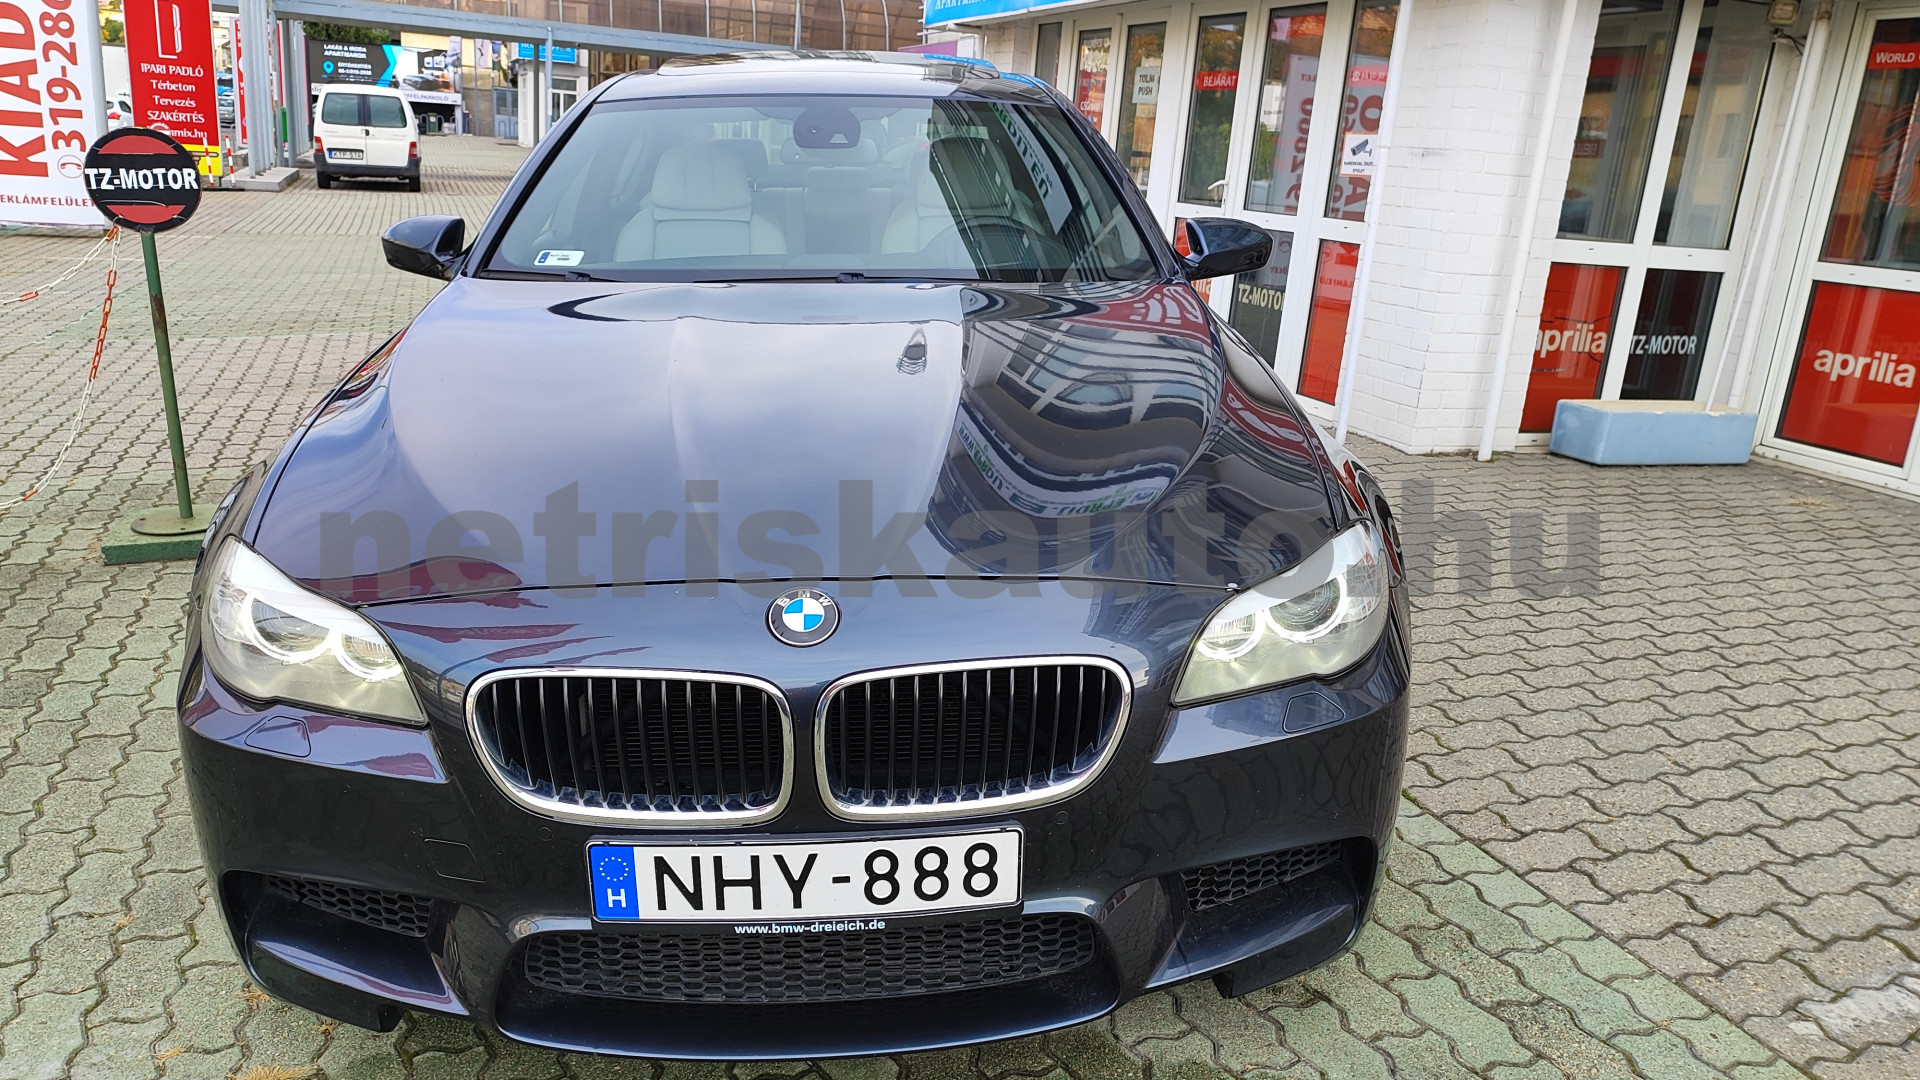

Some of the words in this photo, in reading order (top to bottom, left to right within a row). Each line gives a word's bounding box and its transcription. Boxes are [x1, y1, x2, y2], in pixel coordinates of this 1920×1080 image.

[1876, 52, 1915, 63] WORLD
[140, 63, 166, 74] IPARI
[168, 65, 204, 77] PADLÓ
[150, 79, 196, 92] Térbeton
[1203, 73, 1236, 87] BEJÁRAT
[1138, 86, 1153, 95] PUSH
[152, 95, 196, 108] Tervezés
[147, 109, 205, 123] SZAKÉRTÉS
[85, 168, 199, 190] TZ-MOTOR
[1630, 335, 1697, 355] TZ-MOTOR
[1813, 349, 1917, 388] aprilia
[776, 590, 832, 607] BMW
[653, 842, 999, 911] NHY-888
[607, 888, 627, 908] H
[735, 920, 885, 934] www.bmw-dreieich.de
